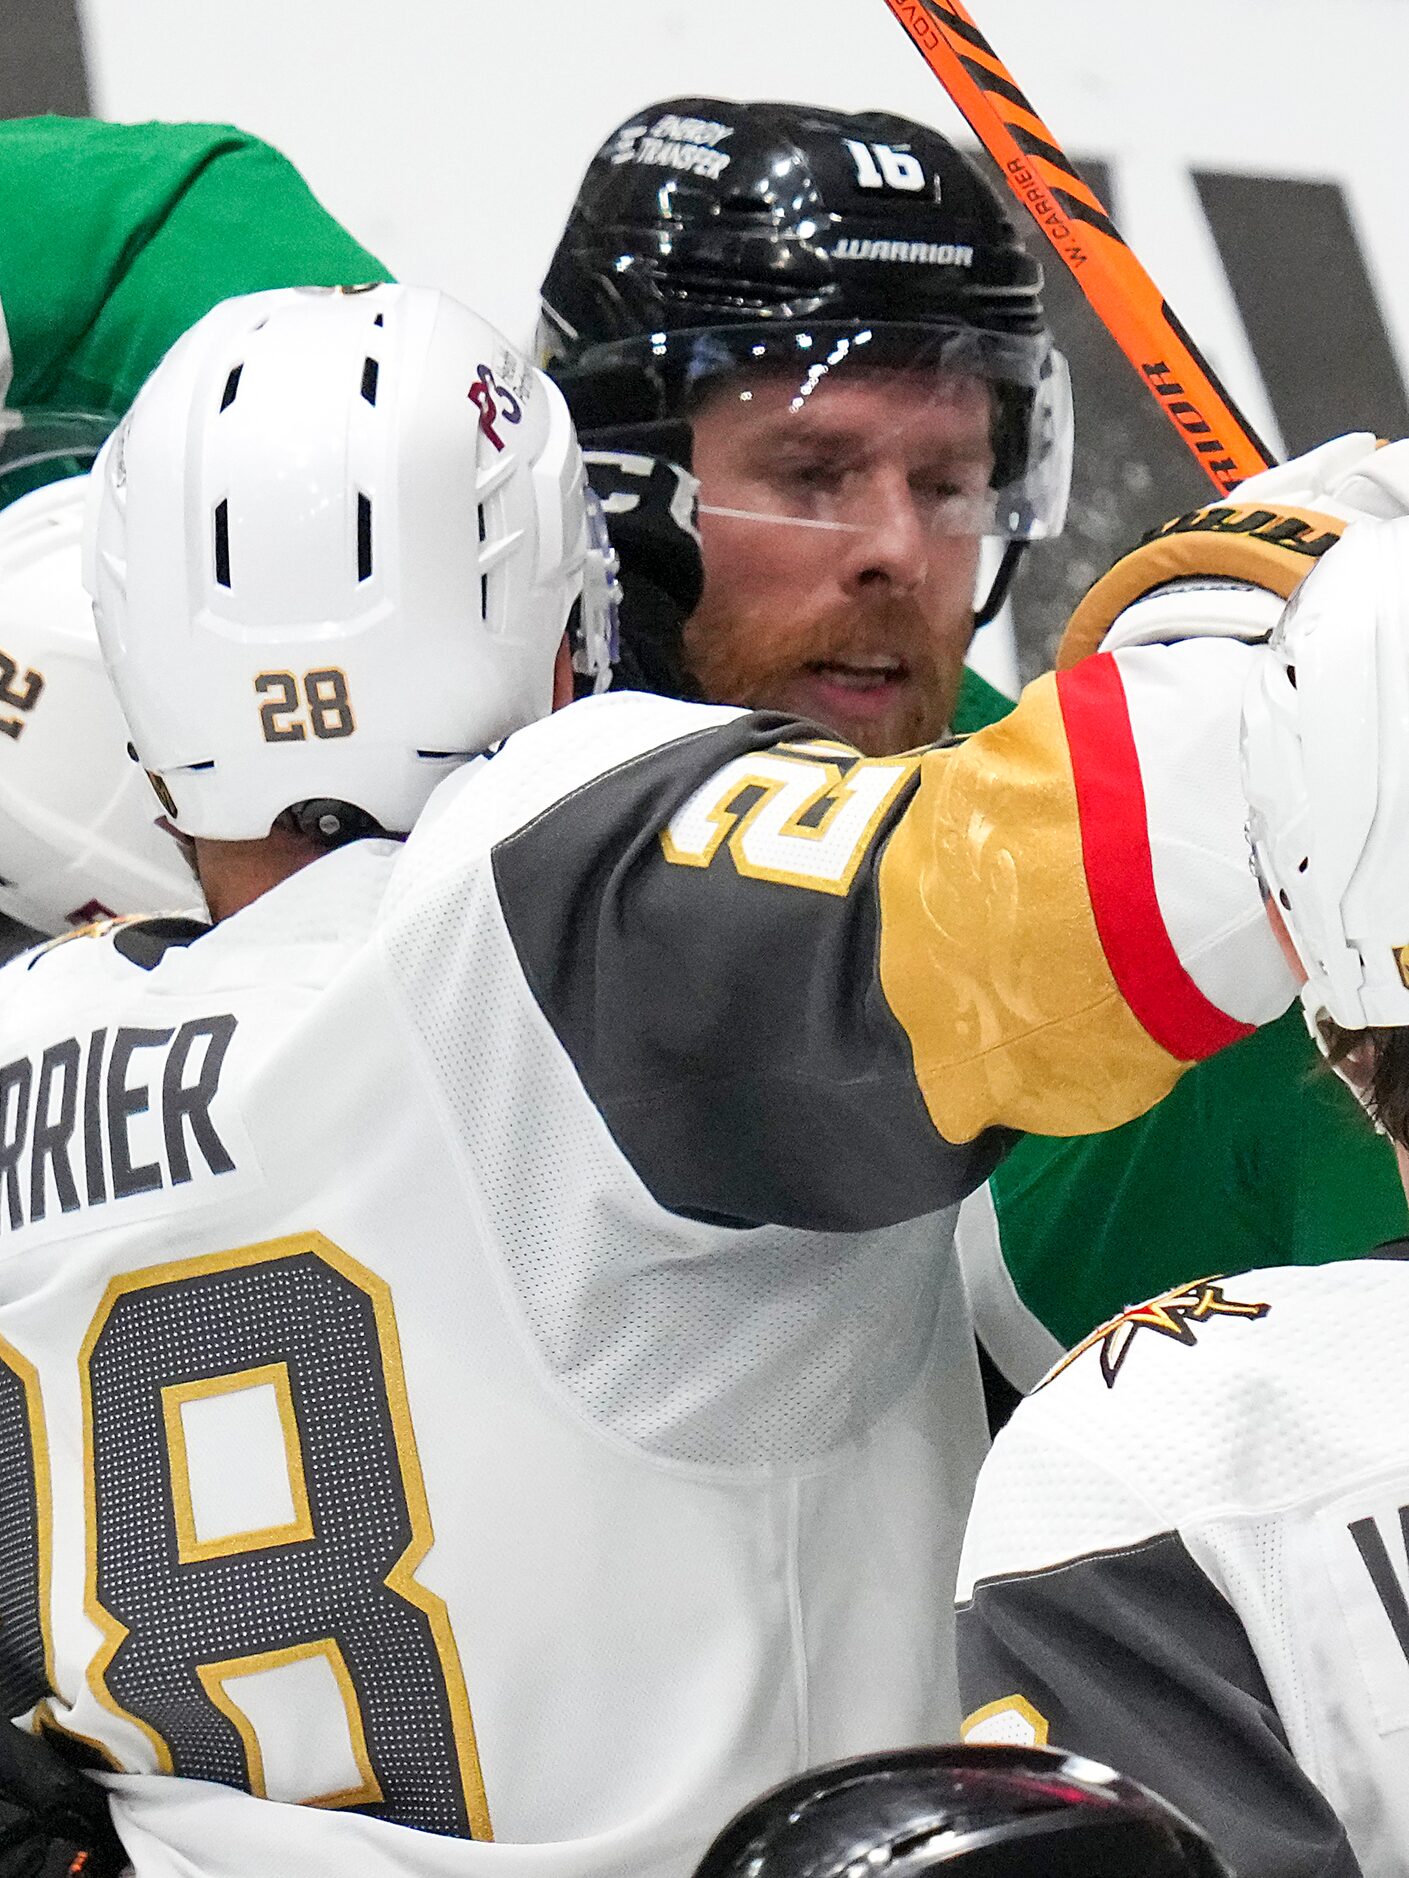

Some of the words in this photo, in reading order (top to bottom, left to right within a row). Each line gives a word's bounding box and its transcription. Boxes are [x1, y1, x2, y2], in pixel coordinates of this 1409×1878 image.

[842, 138, 926, 192] 16
[831, 239, 974, 268] WARRIOR
[253, 666, 356, 743] 28
[659, 738, 921, 896] 2
